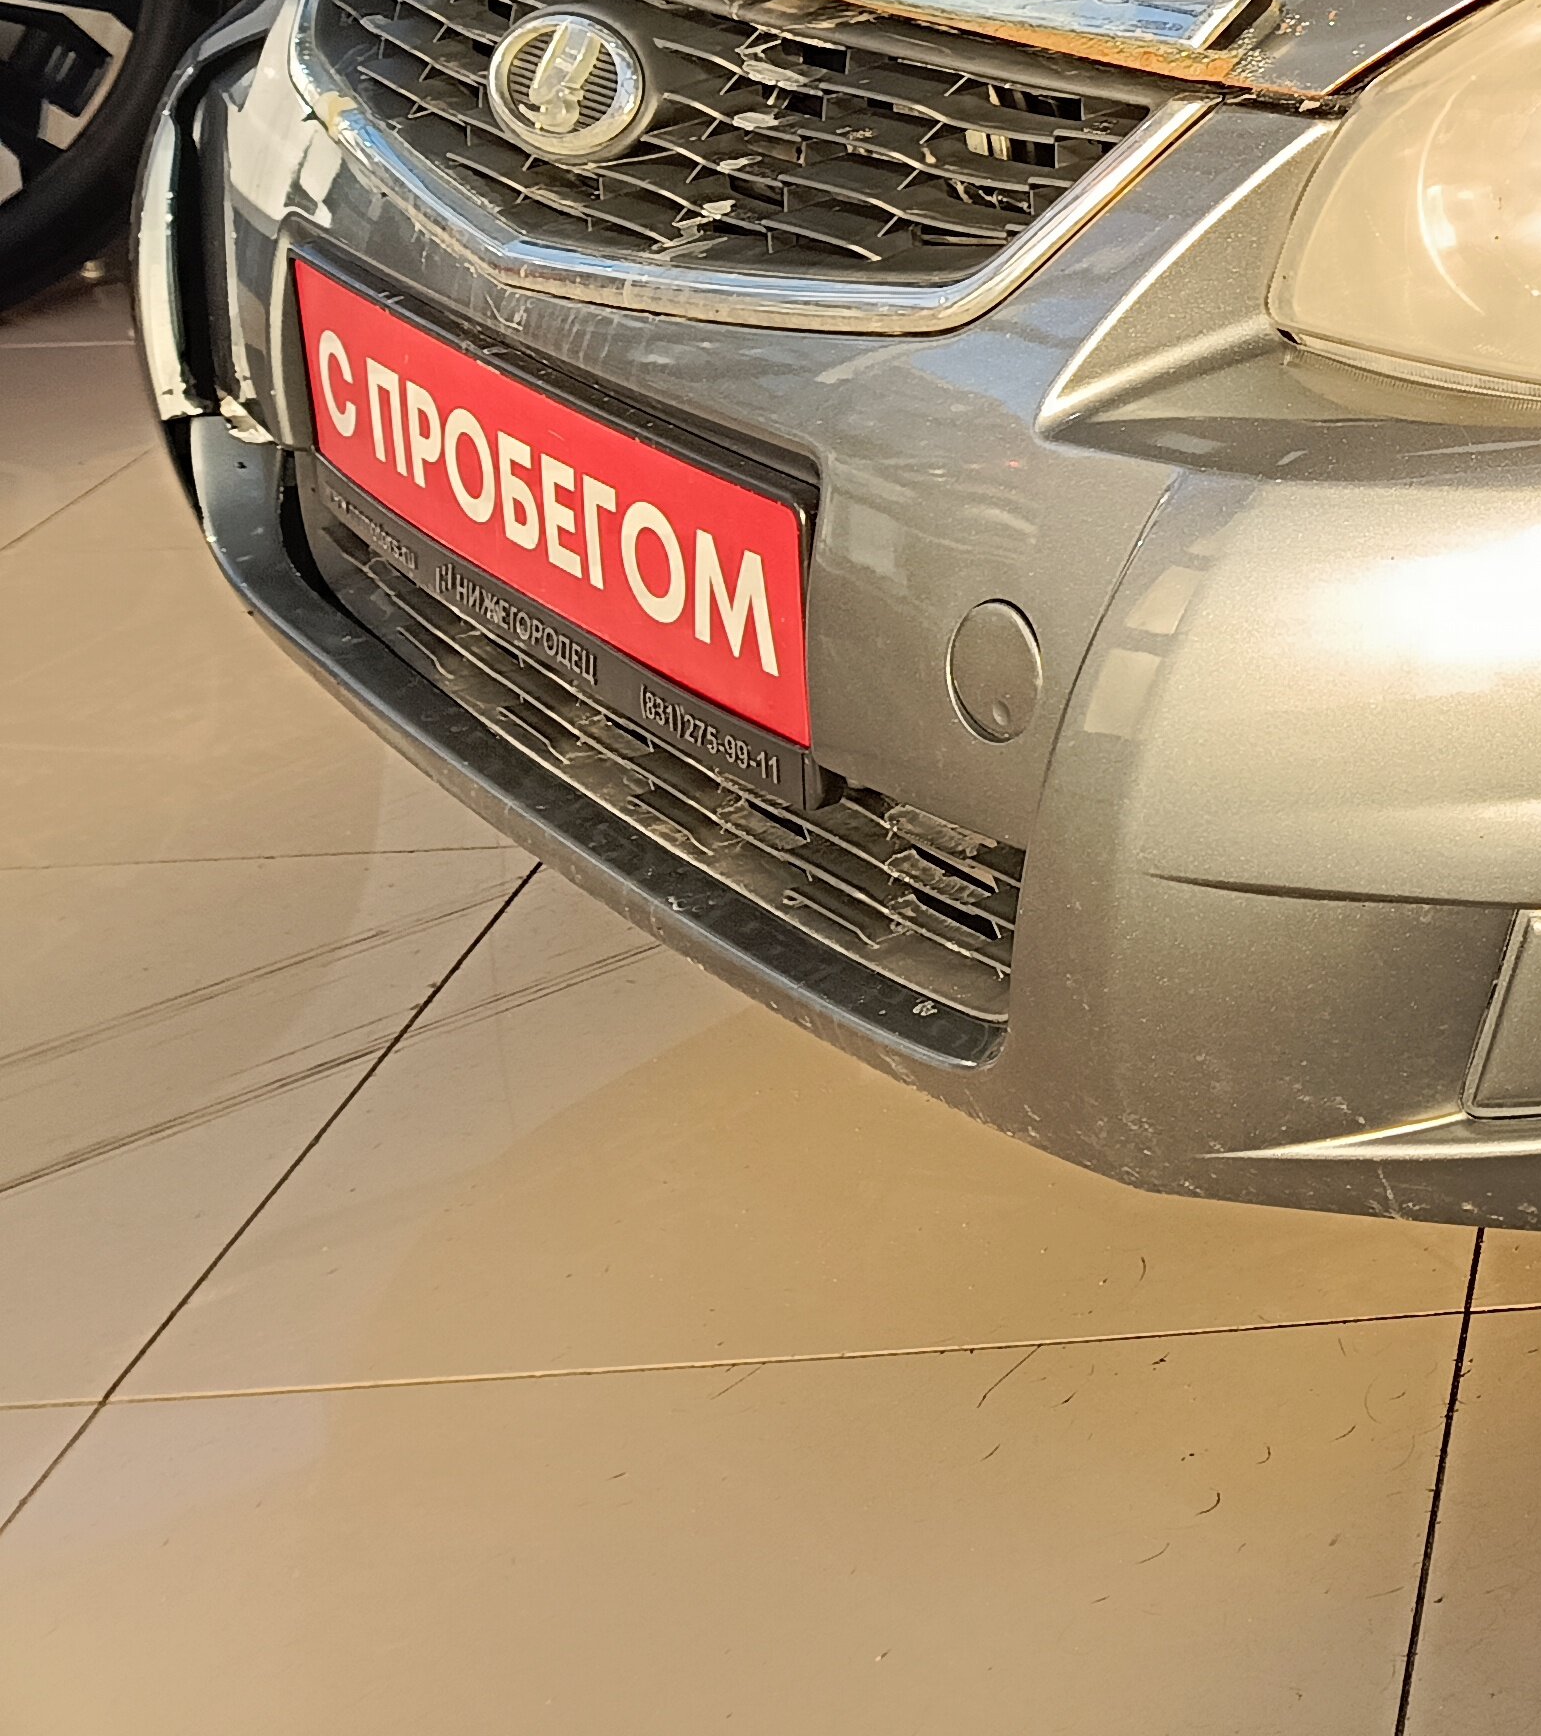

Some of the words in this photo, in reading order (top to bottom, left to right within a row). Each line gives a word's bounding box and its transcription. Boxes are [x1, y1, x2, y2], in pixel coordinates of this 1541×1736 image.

[318, 329, 357, 438] С
[366, 357, 780, 679] ПРОБЕГОМ
[455, 573, 597, 686] НИЖЕГОРОДЕЦ
[640, 683, 682, 739] (831)
[683, 713, 779, 785] 275-99-11
